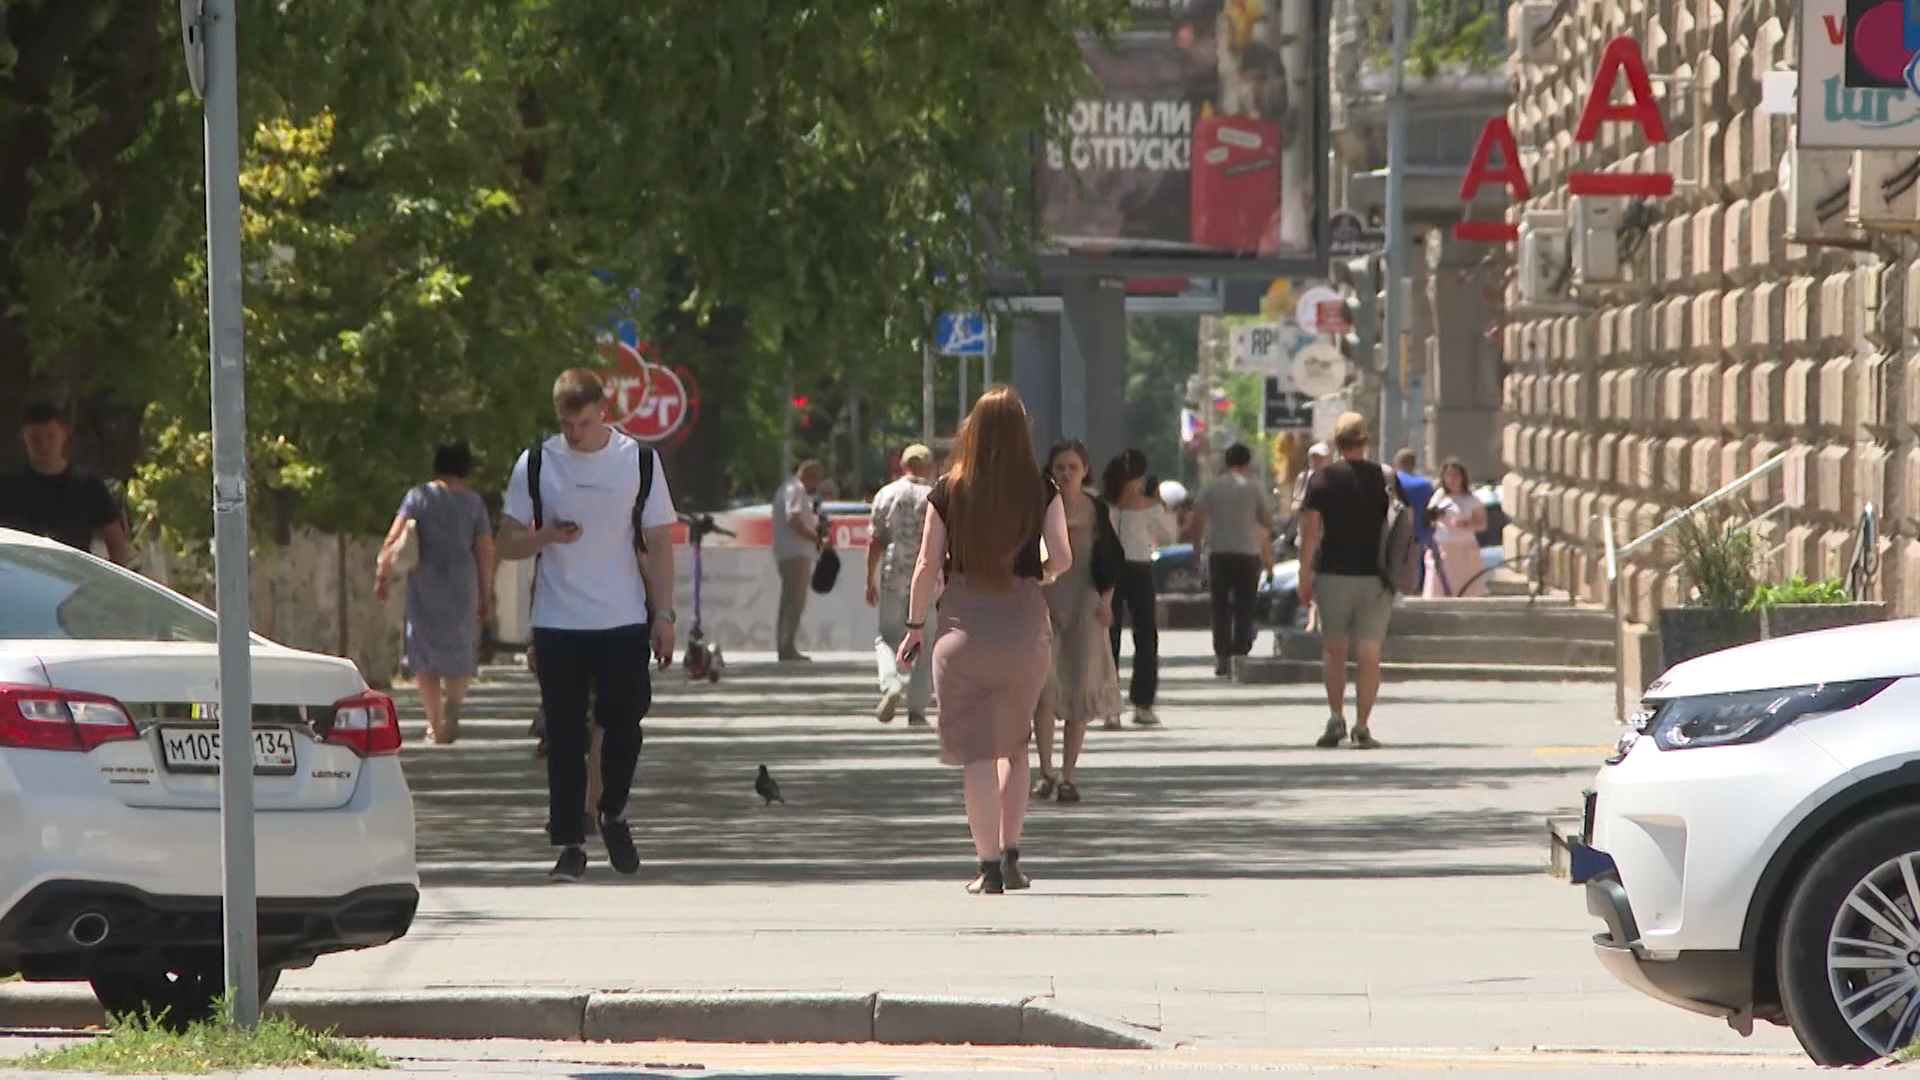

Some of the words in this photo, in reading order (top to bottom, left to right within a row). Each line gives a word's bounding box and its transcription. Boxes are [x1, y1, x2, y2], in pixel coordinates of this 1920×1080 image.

[1822, 75, 1906, 122] tur
[1070, 137, 1191, 170] ОТПУСК!
[256, 733, 289, 754] 134
